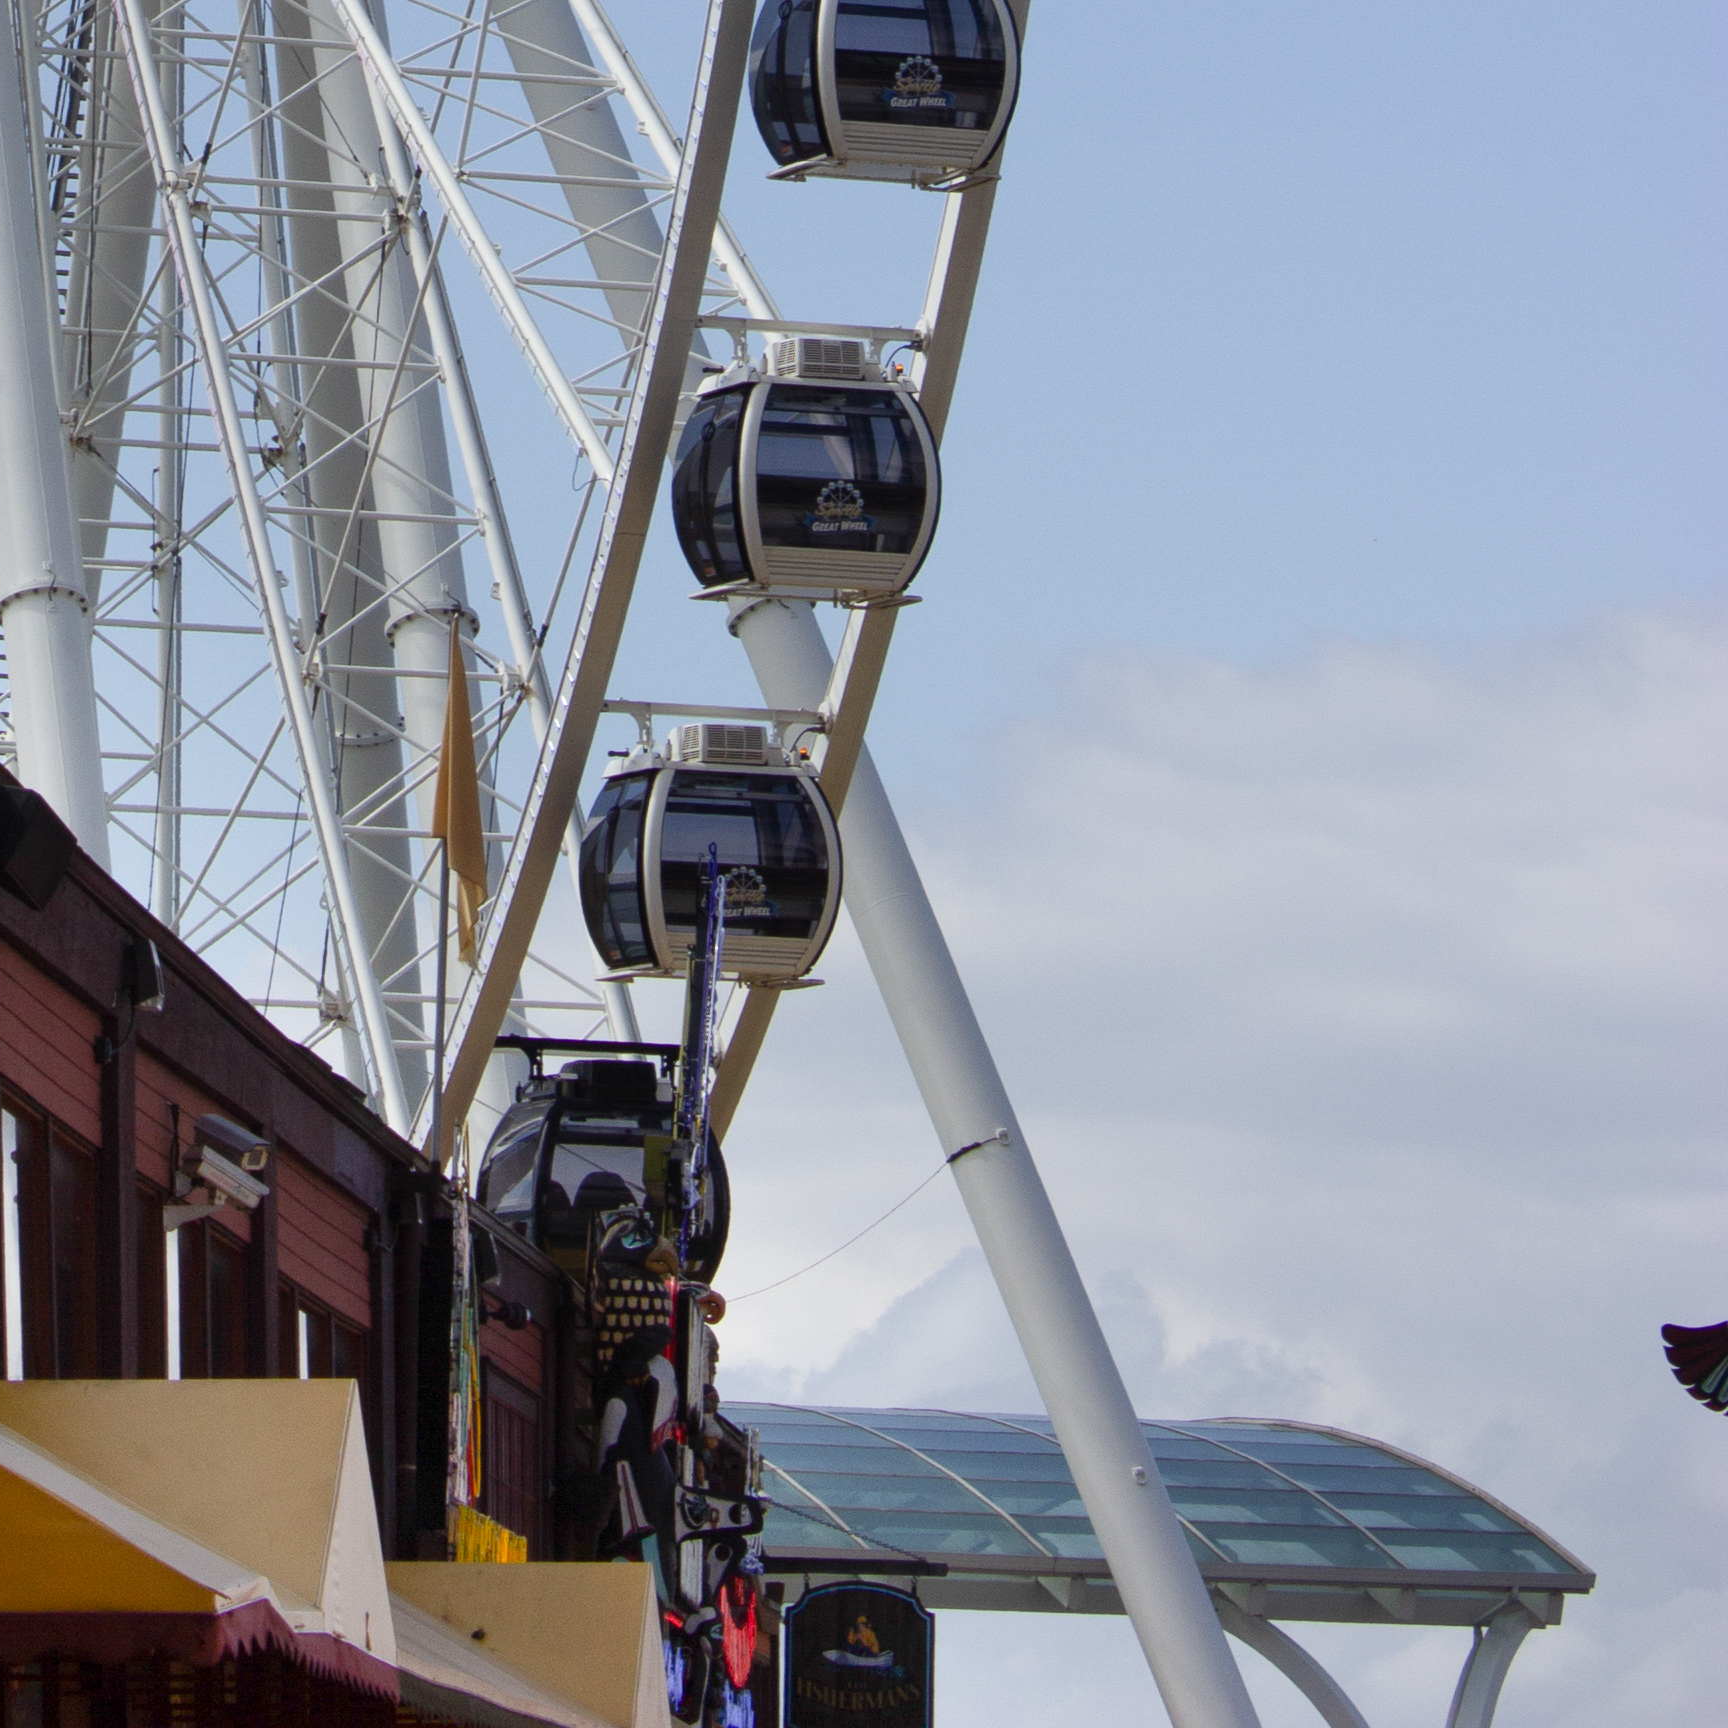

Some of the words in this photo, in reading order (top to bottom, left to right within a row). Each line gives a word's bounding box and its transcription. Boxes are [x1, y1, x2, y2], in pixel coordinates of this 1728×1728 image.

[890, 97, 917, 107] GREAT
[920, 97, 946, 106] WHEEL
[812, 522, 839, 532] GREAT
[841, 521, 868, 531] WHEEL
